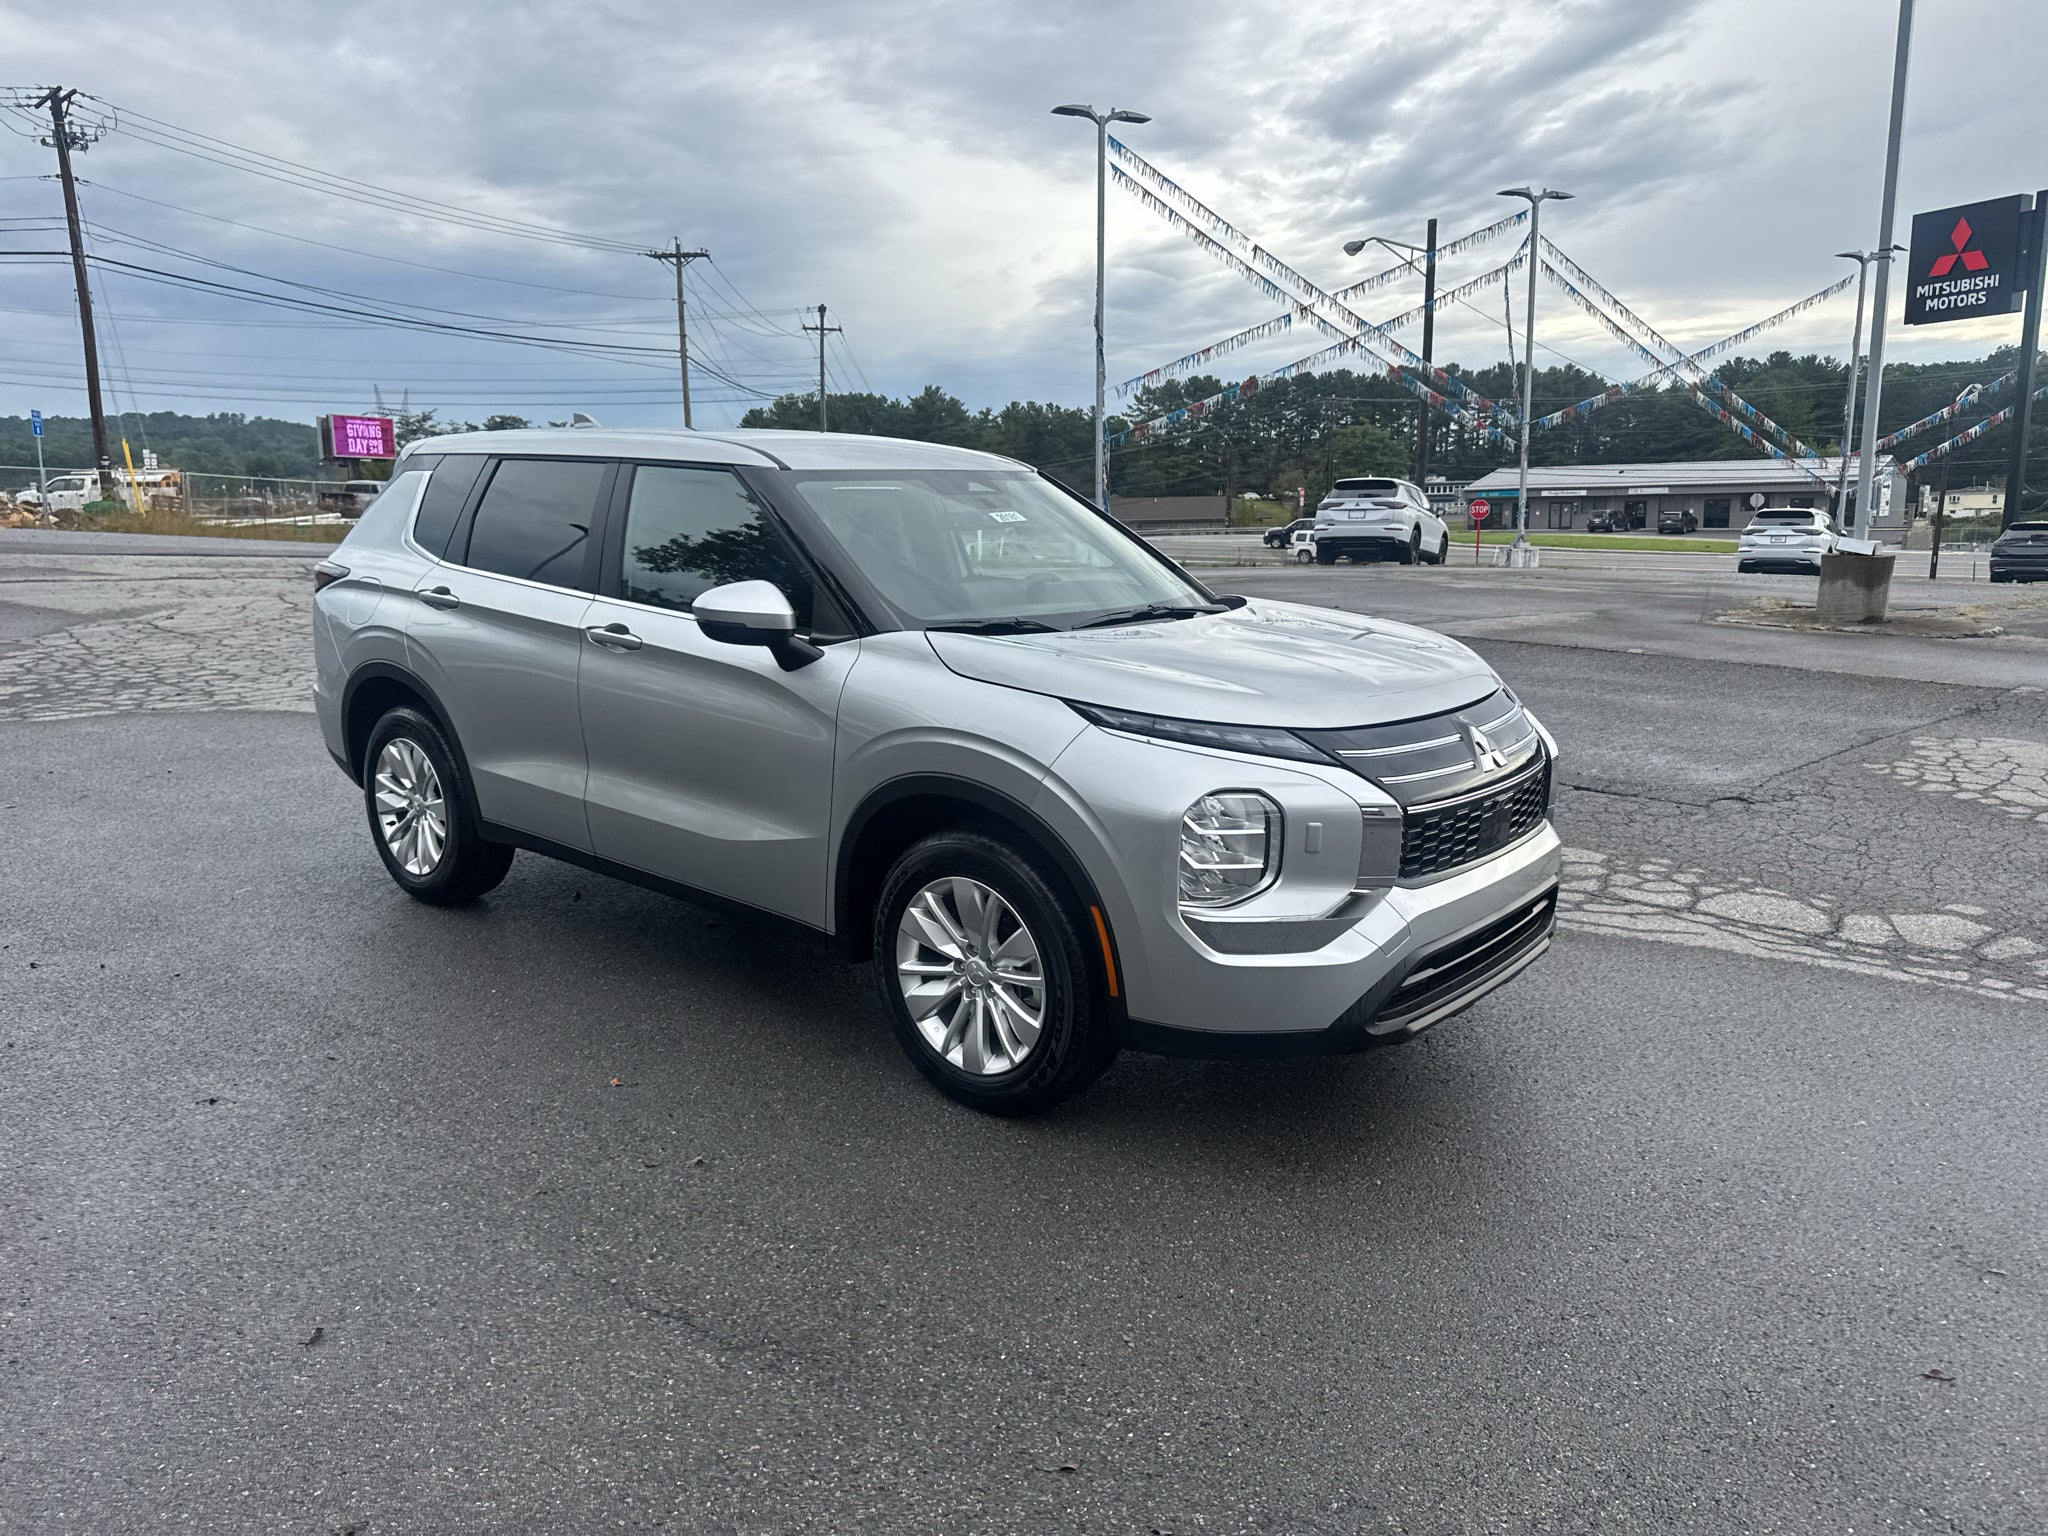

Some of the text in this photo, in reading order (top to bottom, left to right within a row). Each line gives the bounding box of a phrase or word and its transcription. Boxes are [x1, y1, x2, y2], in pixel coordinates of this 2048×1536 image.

[1916, 274, 2000, 298] MITSUBISHI
[1925, 291, 1987, 312] MOTORS
[348, 438, 368, 454] DAY
[1471, 505, 1489, 514] STOP
[880, 867, 910, 917] TIRES
[1054, 980, 1065, 1043] TOYO
